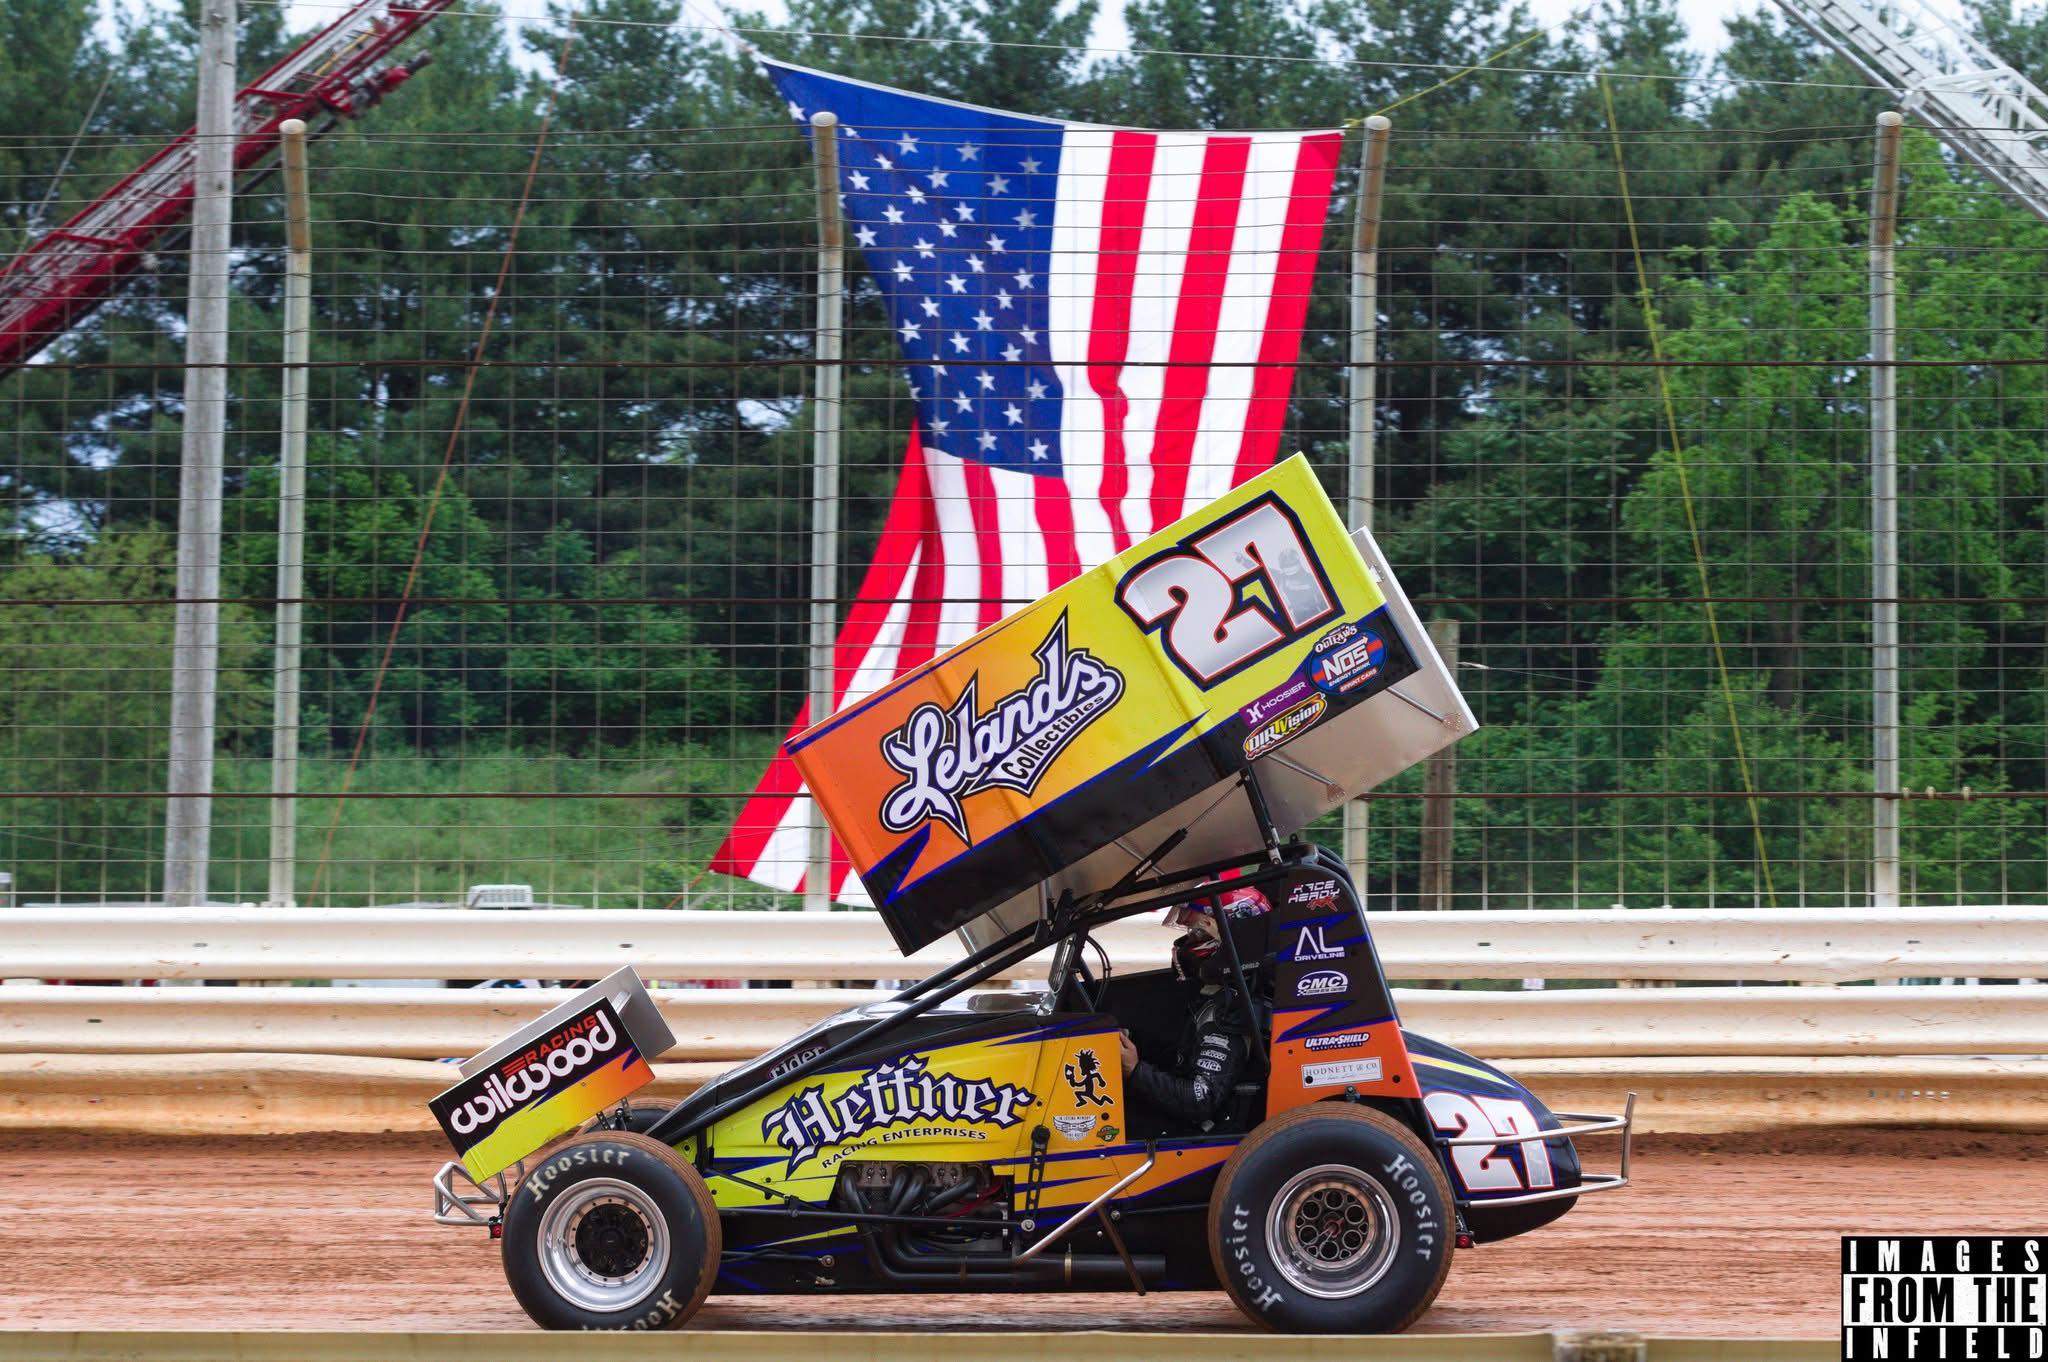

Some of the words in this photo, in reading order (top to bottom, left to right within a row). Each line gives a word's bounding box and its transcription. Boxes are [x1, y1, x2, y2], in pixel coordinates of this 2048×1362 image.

[1119, 497, 1337, 685] 27
[1261, 681, 1306, 711] HOOSIER
[1322, 636, 1369, 681] NOS
[884, 614, 1122, 828] Lelands
[1001, 695, 1104, 780] Collectibles
[1294, 951, 1345, 962] DRIVELINE
[1297, 976, 1342, 990] CMC
[451, 1010, 617, 1134] wilwood
[525, 1014, 597, 1064] RACING
[764, 1056, 1035, 1174] Heffner
[822, 1137, 878, 1169] RACING
[883, 1127, 988, 1143] ENTERPRISES
[1423, 1092, 1554, 1191] 27
[525, 1148, 631, 1202] Hoosier
[1383, 1153, 1438, 1262] Hoosier
[1226, 1204, 1285, 1312] Hoosier
